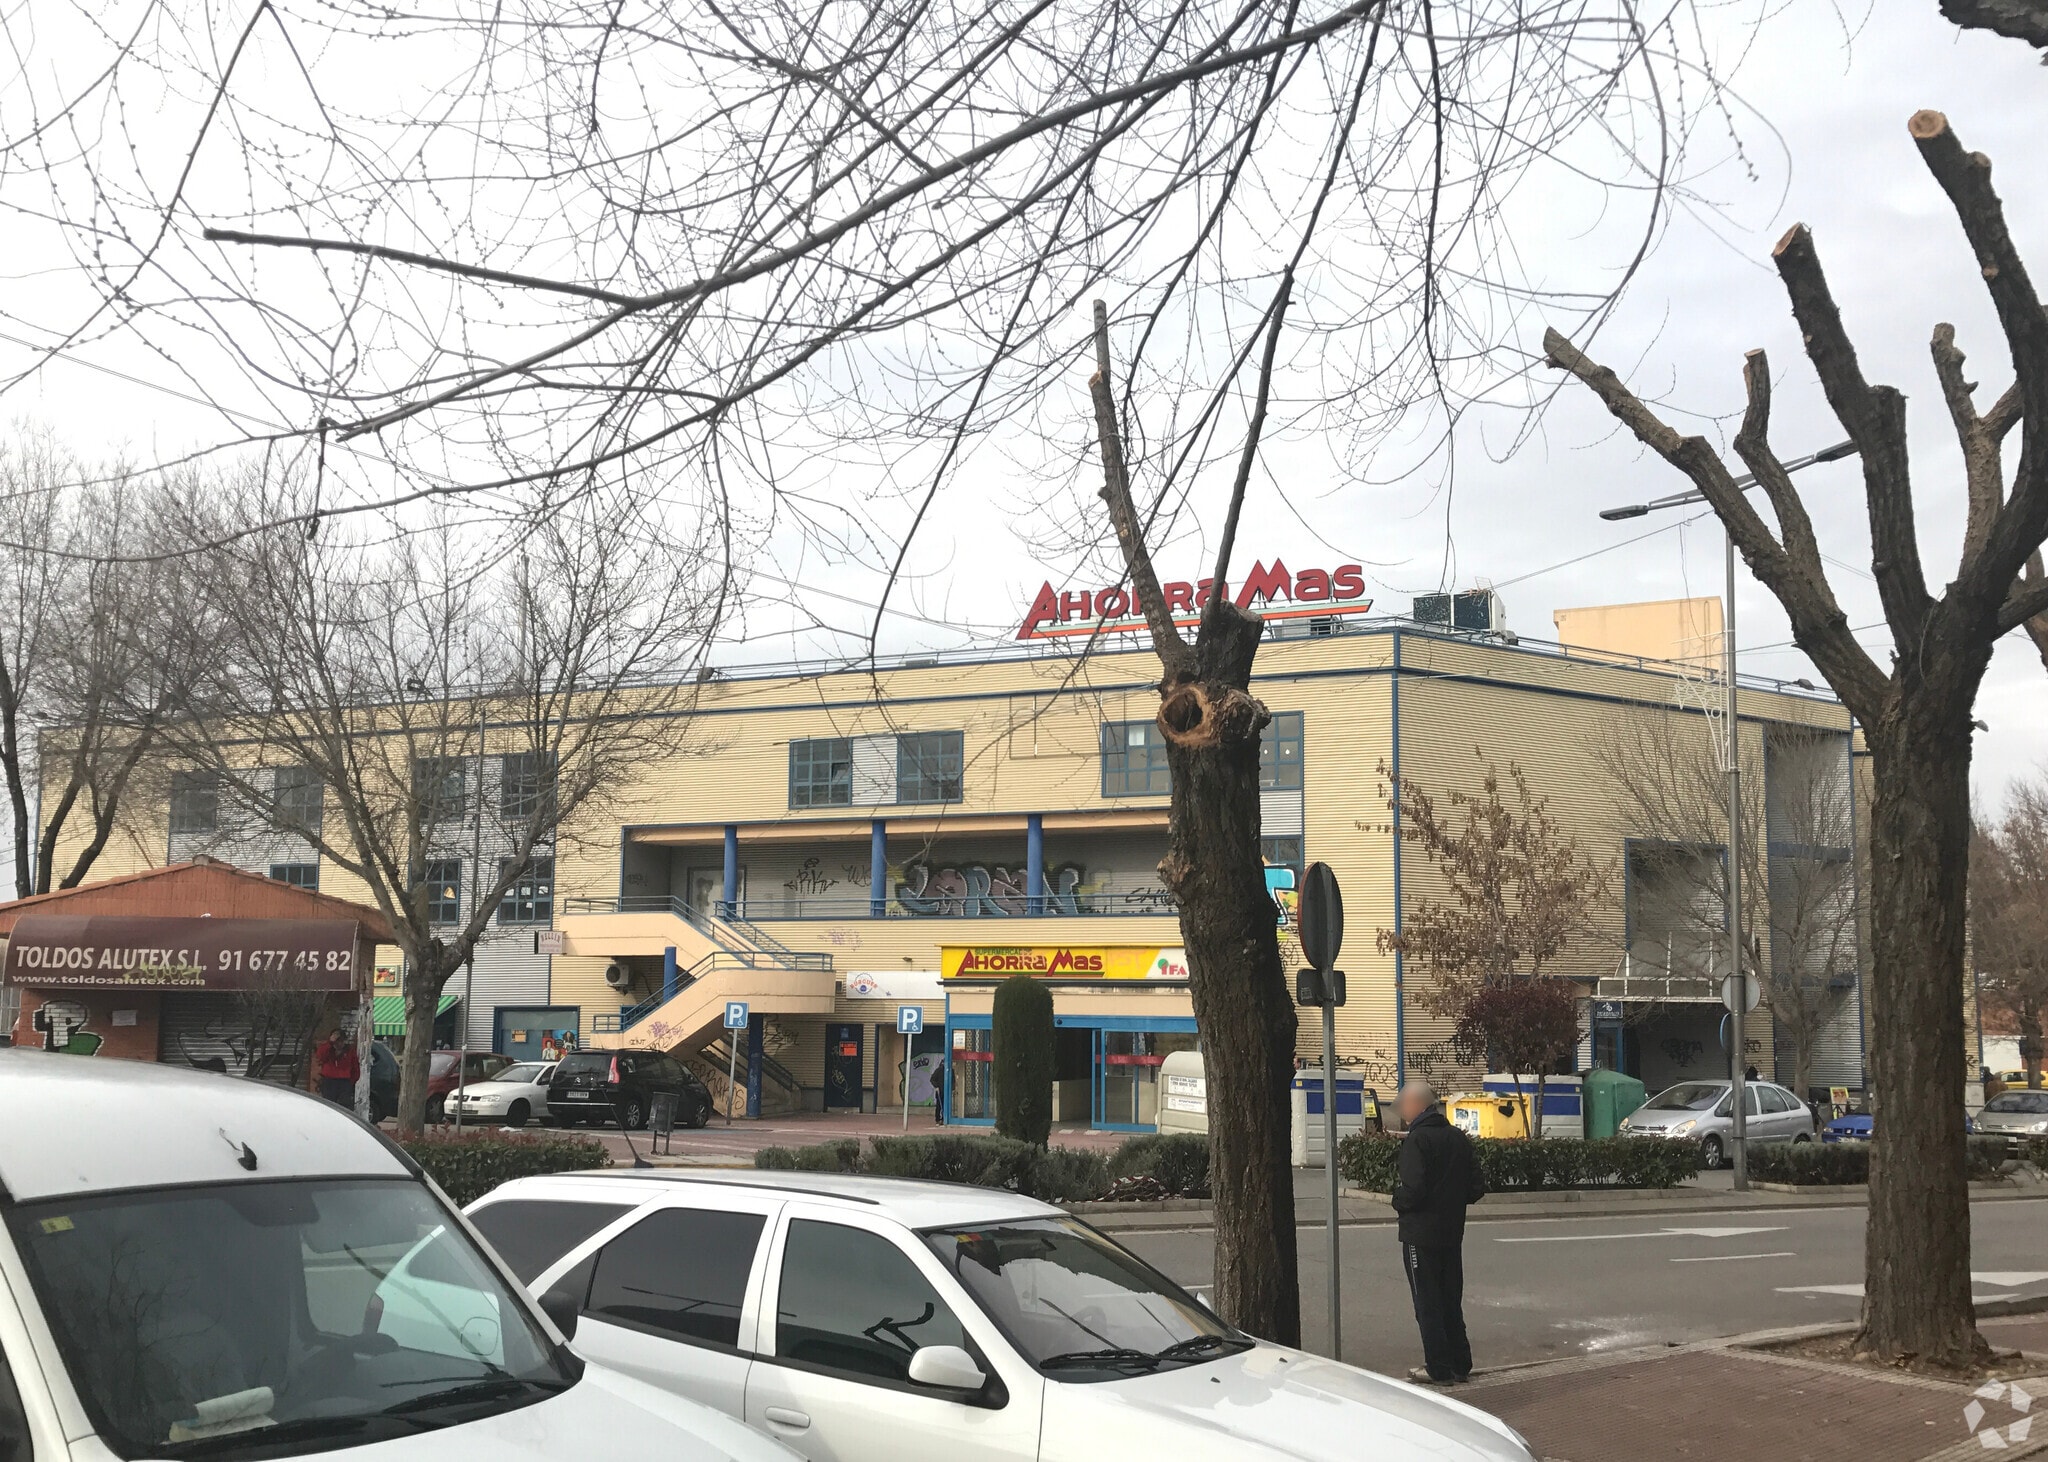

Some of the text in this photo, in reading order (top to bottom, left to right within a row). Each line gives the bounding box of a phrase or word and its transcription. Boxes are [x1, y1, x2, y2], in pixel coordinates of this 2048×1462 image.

[16, 946, 95, 968] TOLDOS
[98, 948, 174, 970] ALUTEX
[218, 950, 243, 971] 91
[249, 950, 289, 971] 677
[294, 951, 320, 971] 45
[325, 950, 351, 971] 82
[12, 974, 206, 987] www.toldosalutex.com
[729, 1005, 744, 1025] P
[903, 1009, 918, 1031] P
